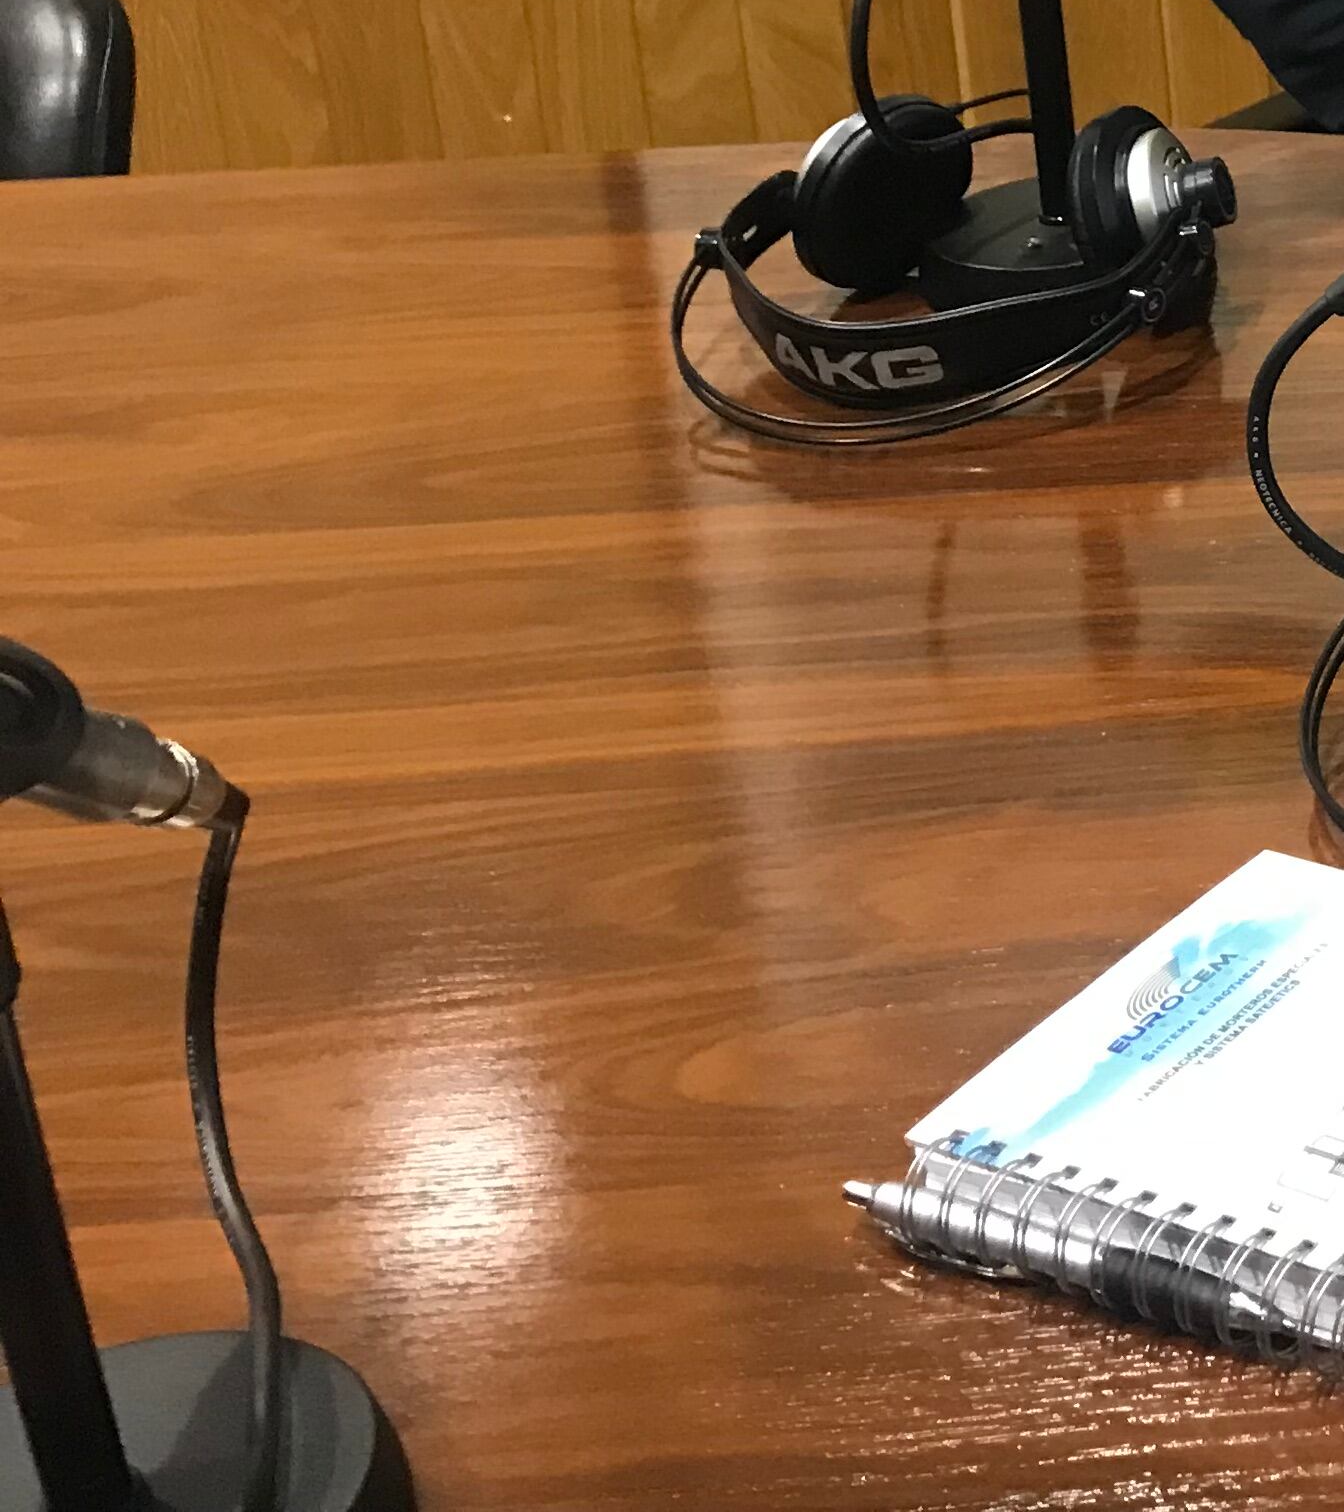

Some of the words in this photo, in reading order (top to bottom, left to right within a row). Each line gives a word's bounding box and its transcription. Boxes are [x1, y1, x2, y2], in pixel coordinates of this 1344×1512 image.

[775, 332, 945, 390] AKG
[1106, 953, 1239, 1055] EUROCEM
[1202, 1032, 1219, 1046] DE
[1217, 988, 1274, 1034] MORTEROS
[1203, 1025, 1249, 1060] SISTEMA
